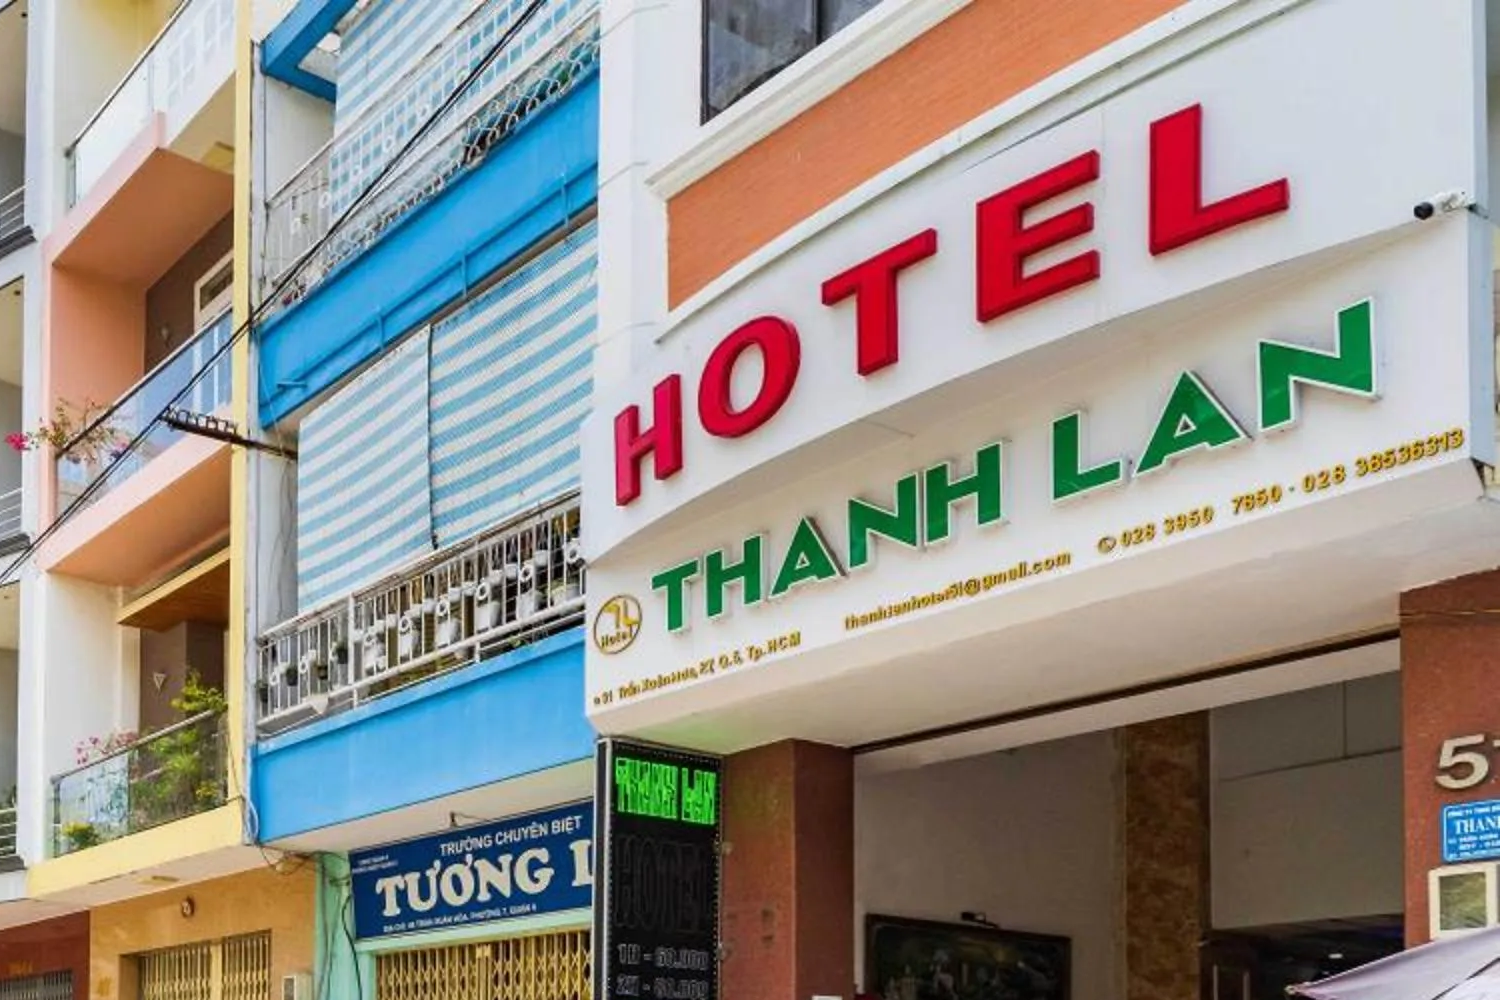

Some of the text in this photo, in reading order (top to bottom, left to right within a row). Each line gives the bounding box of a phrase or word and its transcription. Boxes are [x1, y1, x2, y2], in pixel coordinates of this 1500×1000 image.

[615, 102, 1289, 507] HOTEL
[651, 297, 1373, 633] THANH LAN
[1120, 522, 1156, 548] 028
[1163, 506, 1214, 535] 3950
[1302, 464, 1347, 494] 028
[601, 626, 634, 649] Hotel
[747, 630, 802, 661] Tp.HCM
[1435, 734, 1500, 790] 5
[439, 814, 584, 857] TRƯỜNG CHUYÊN BIỆT
[375, 847, 555, 918] TƯƠNG
